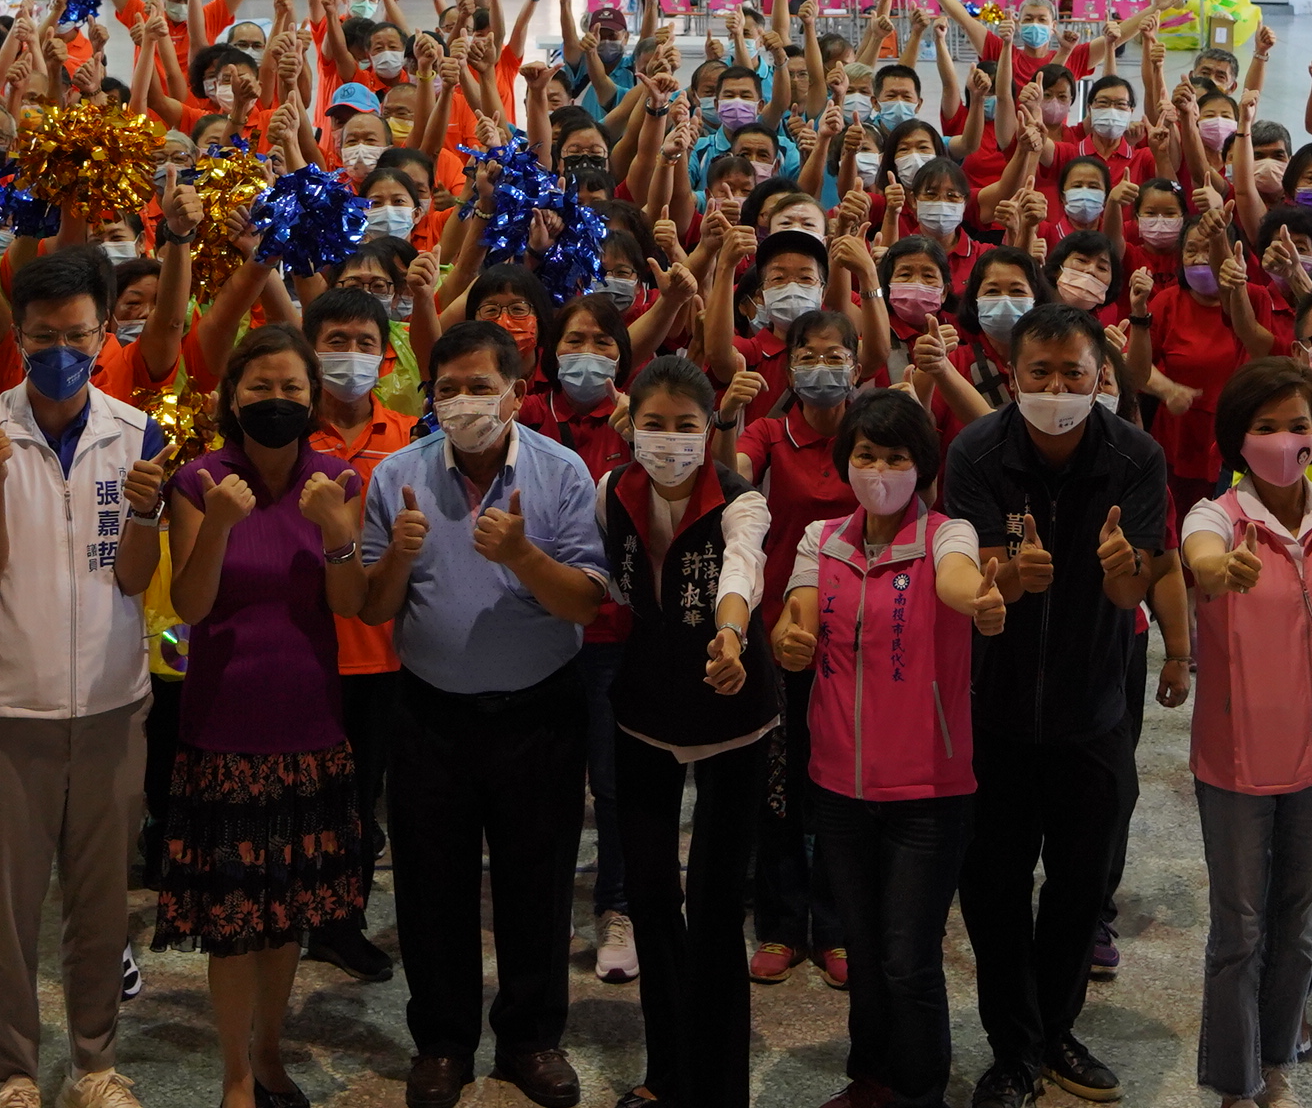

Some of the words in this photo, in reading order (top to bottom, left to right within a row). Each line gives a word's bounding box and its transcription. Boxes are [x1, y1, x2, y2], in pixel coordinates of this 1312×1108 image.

[86, 543, 98, 573] 議員
[95, 480, 120, 569] 張嘉哲
[680, 552, 706, 627] 許淑華
[891, 593, 907, 682] 南投市民代表
